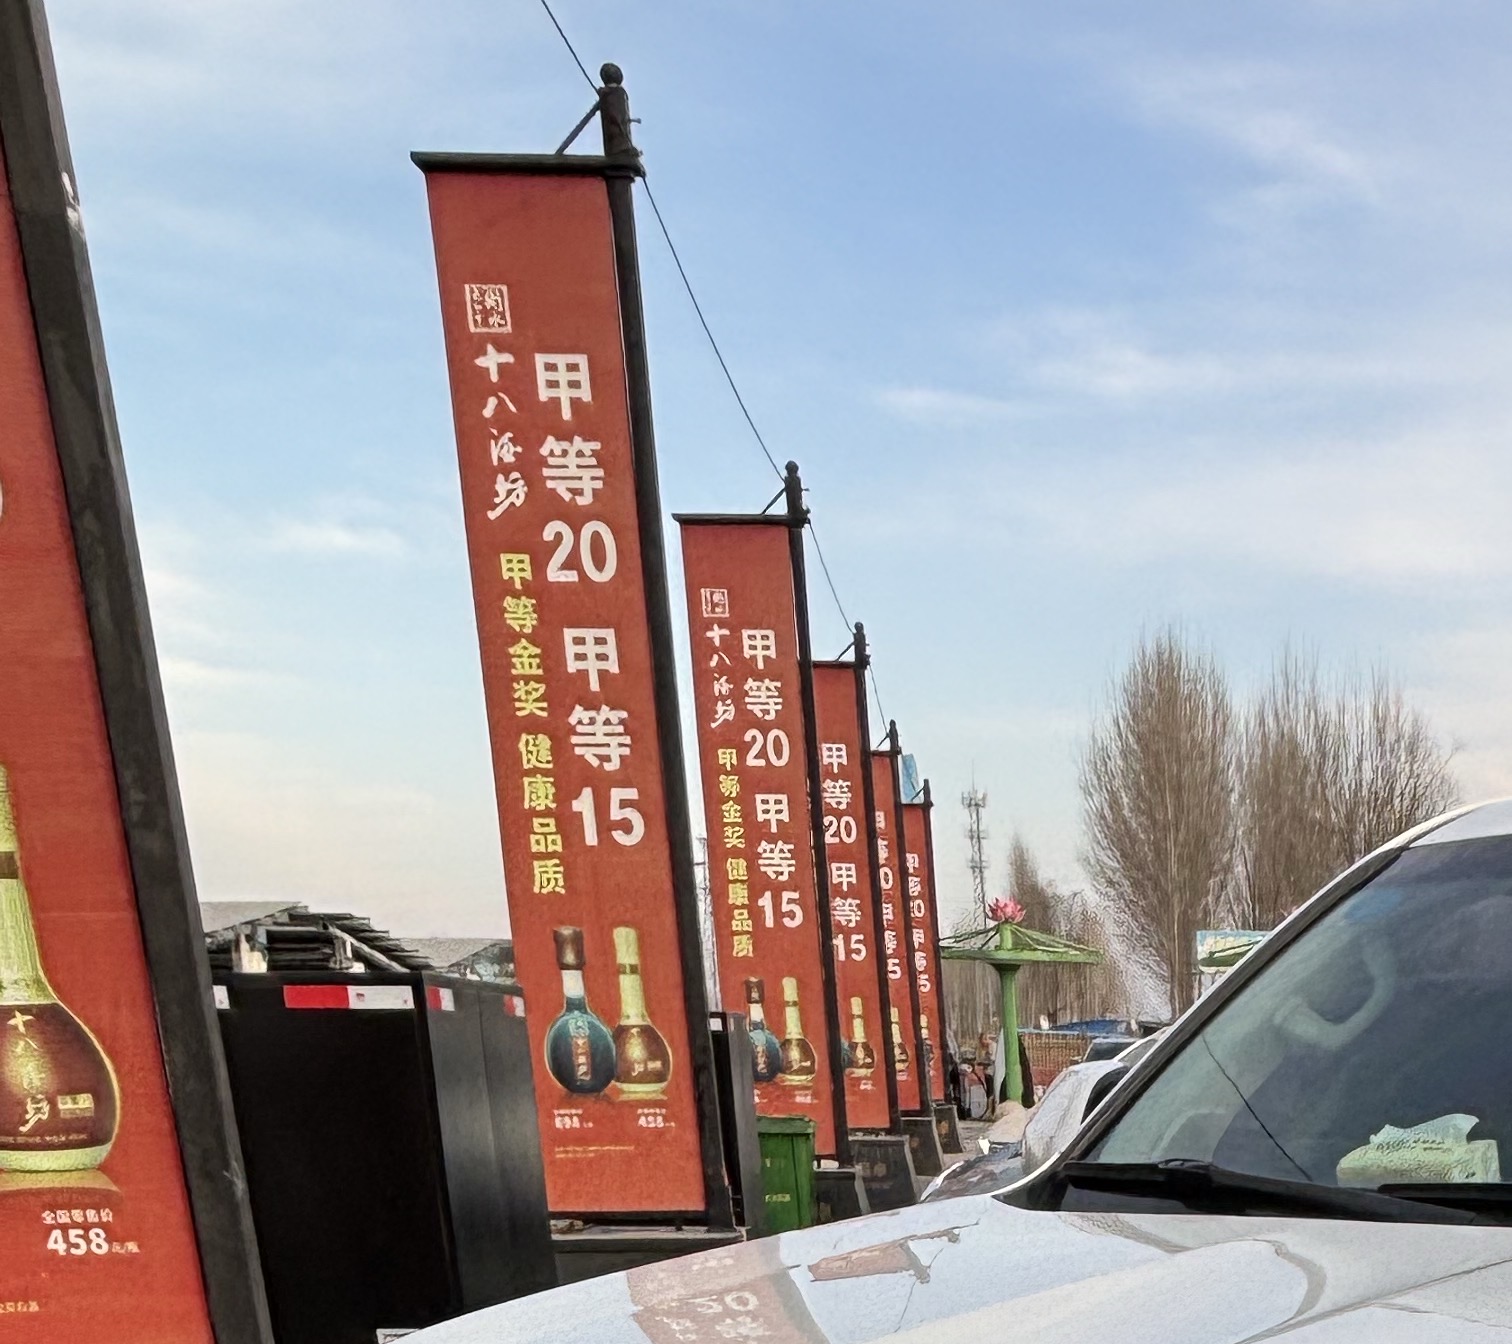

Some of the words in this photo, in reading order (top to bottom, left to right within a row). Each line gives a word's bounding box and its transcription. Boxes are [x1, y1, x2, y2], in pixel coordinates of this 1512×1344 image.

[500, 553, 549, 719] 甲等金奖
[518, 731, 566, 894] 健康品质
[47, 1227, 110, 1256] 458
